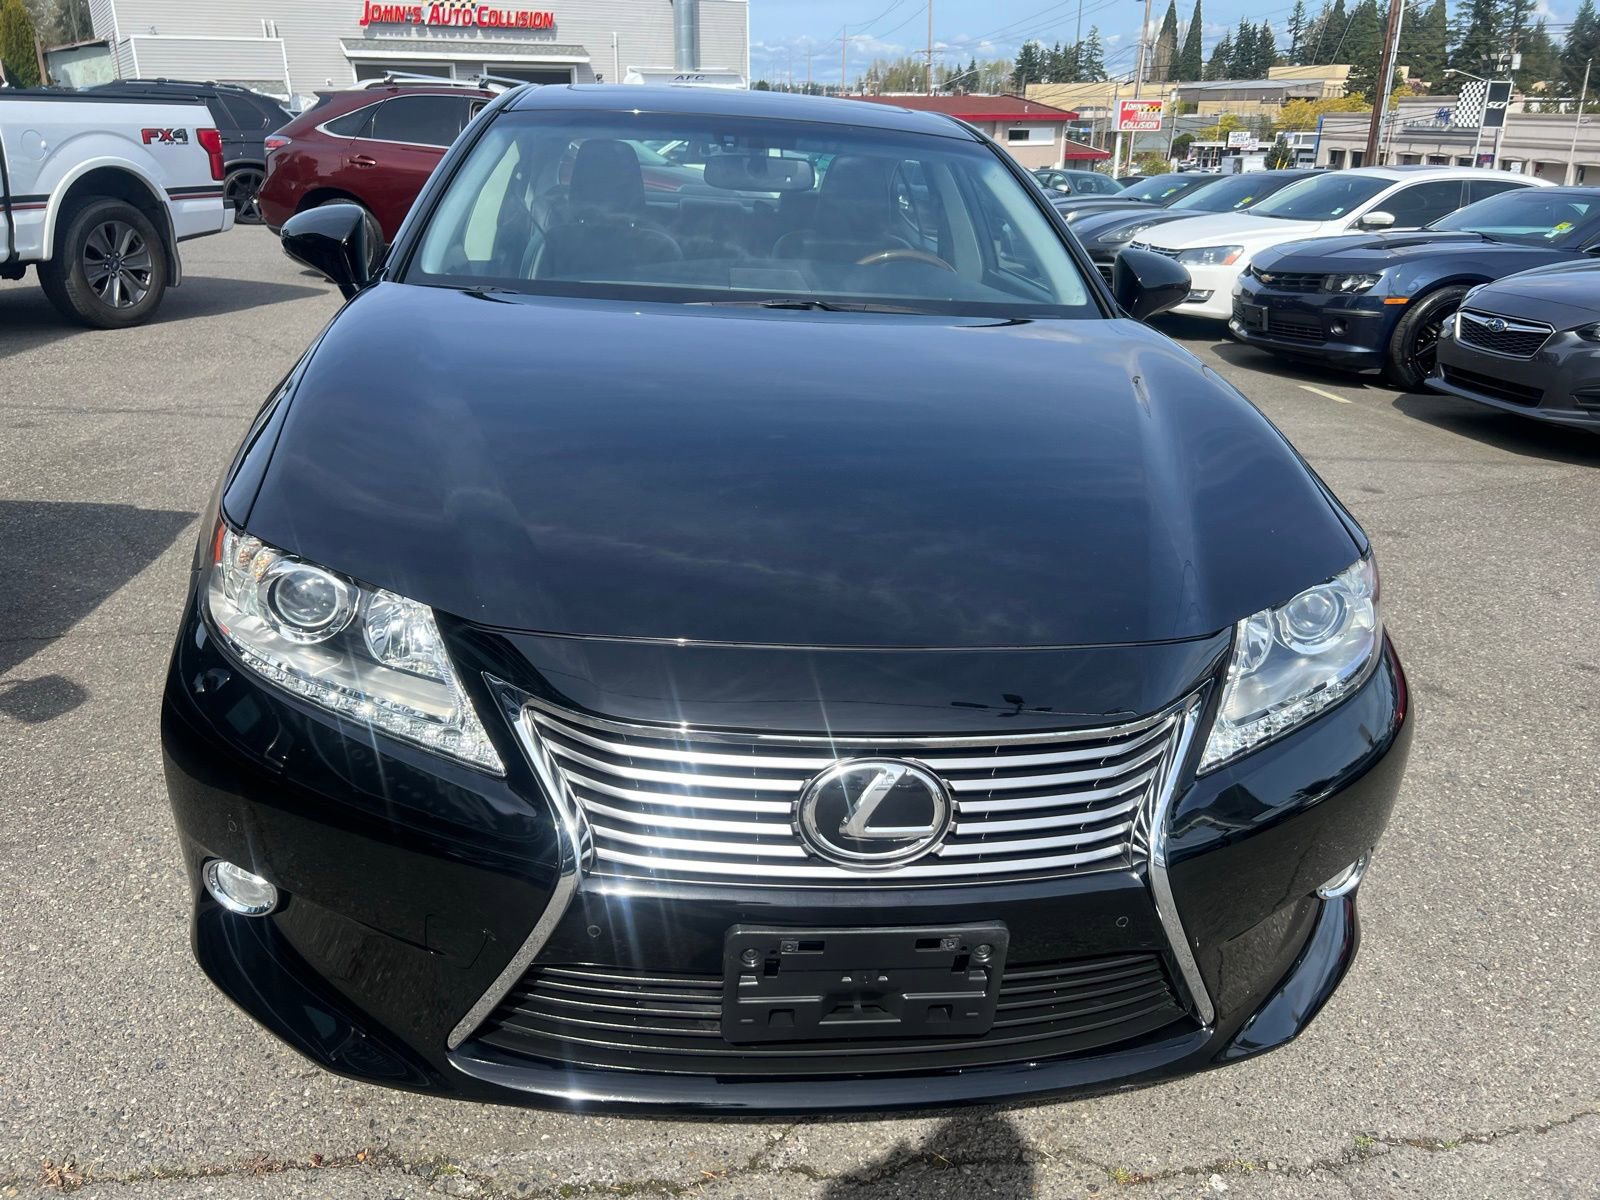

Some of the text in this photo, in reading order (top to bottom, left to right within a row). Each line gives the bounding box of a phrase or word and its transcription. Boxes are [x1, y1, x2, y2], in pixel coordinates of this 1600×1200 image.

[359, 0, 554, 28] JOHN'S AUTO COLLISION
[1121, 120, 1159, 129] COLLISION
[140, 128, 188, 144] FX4
